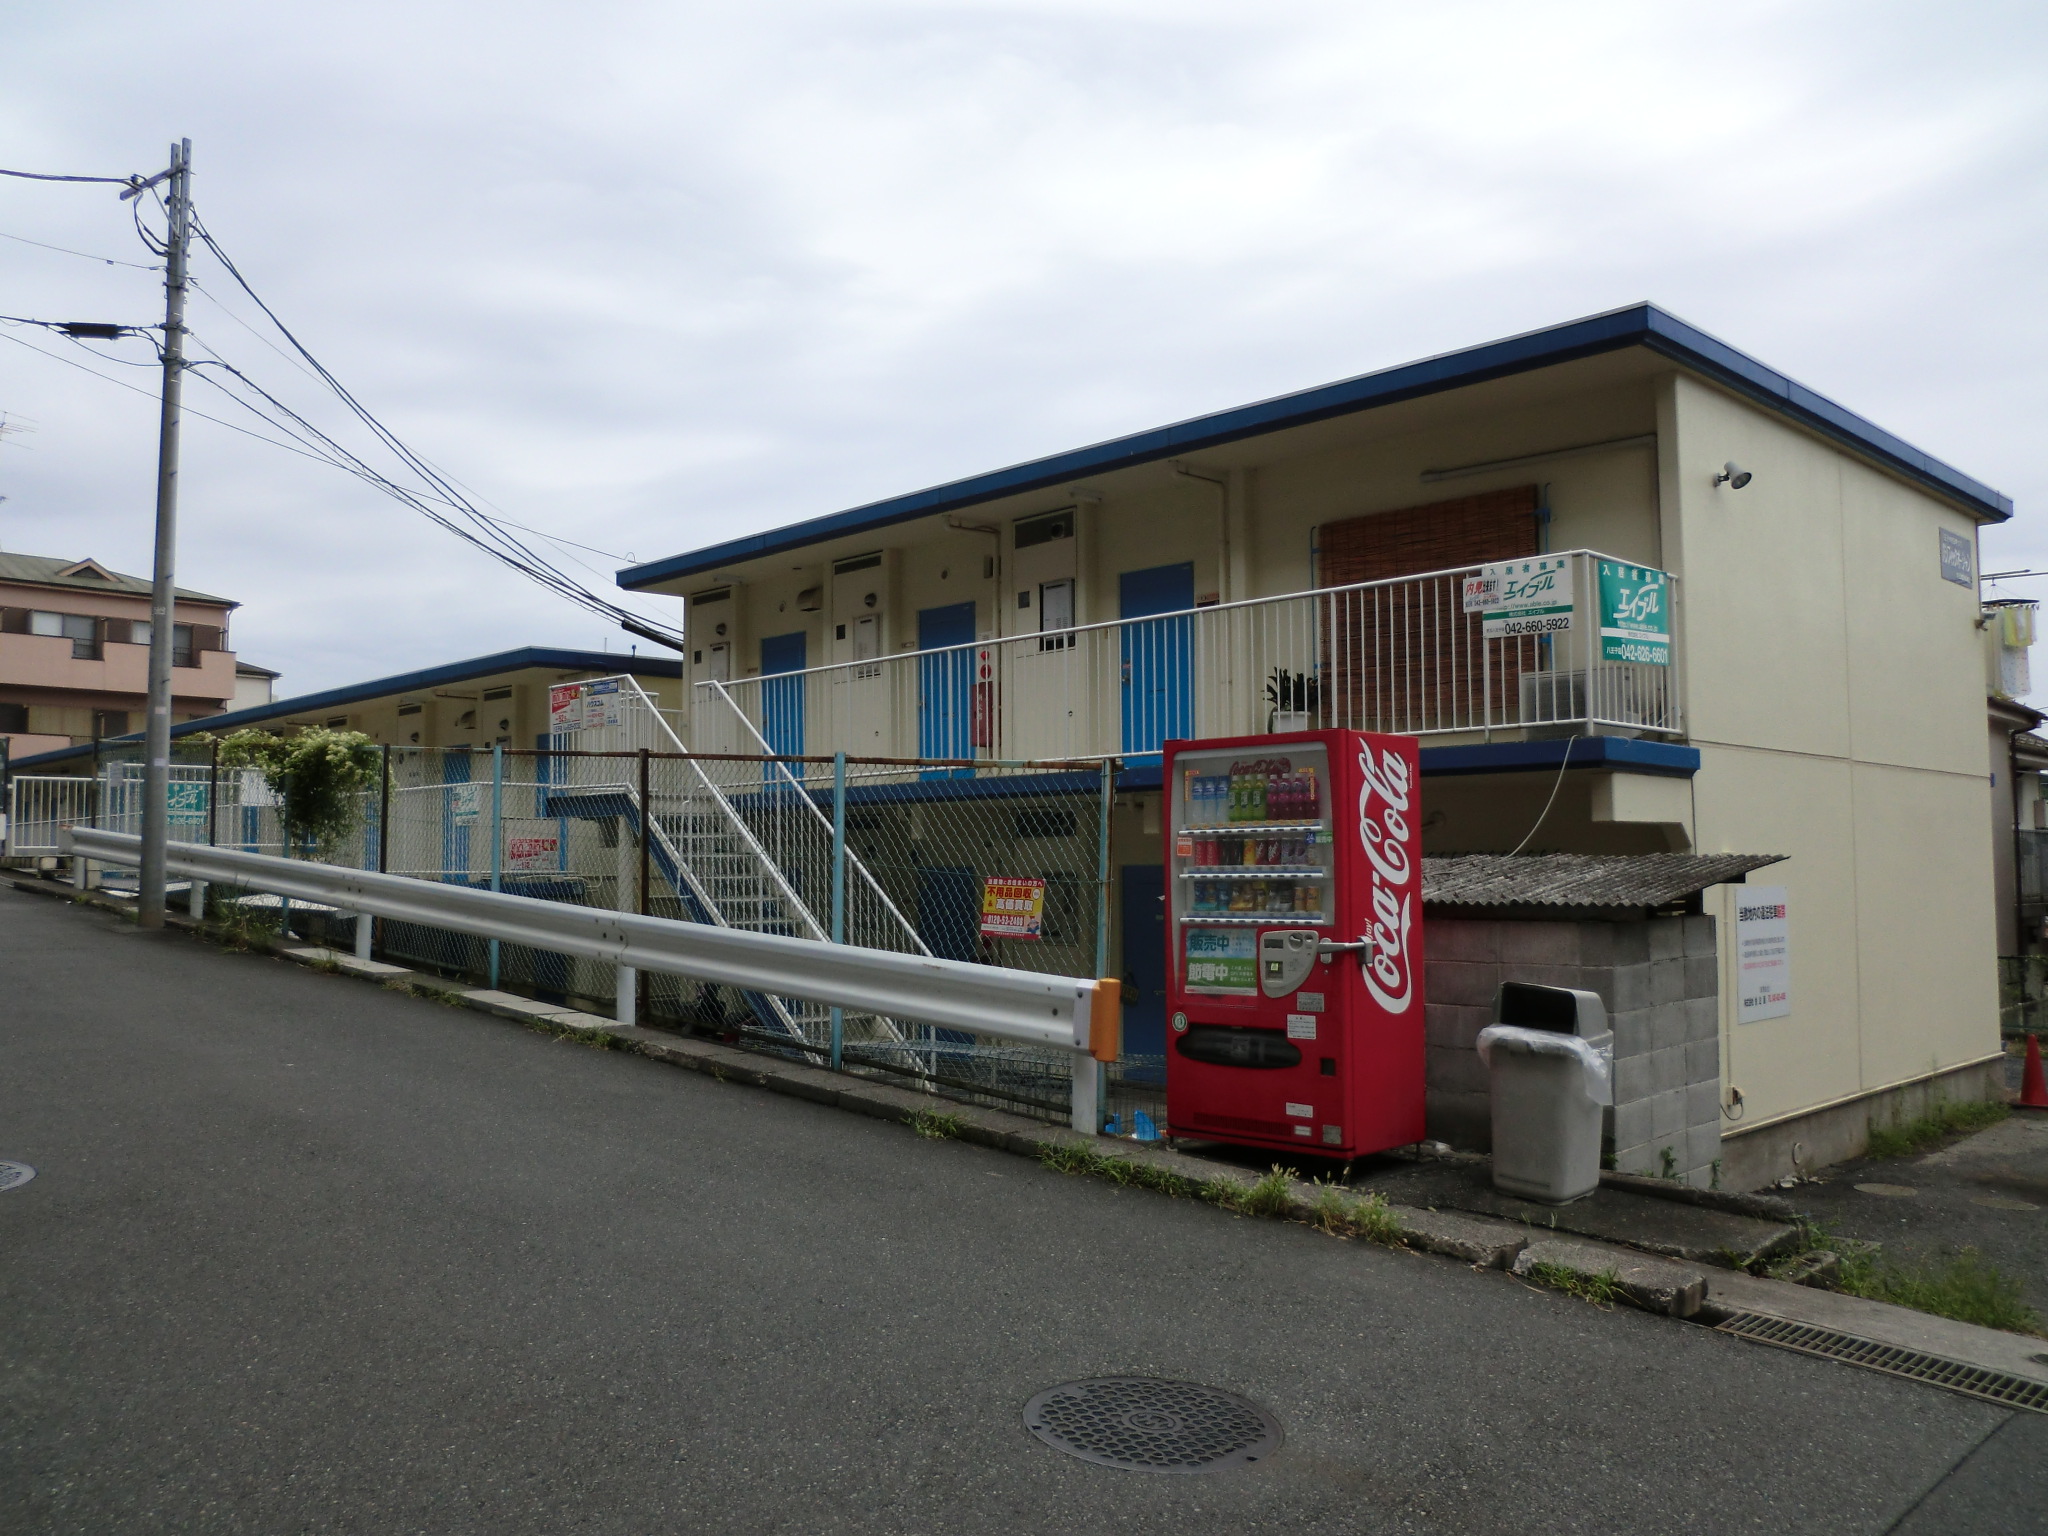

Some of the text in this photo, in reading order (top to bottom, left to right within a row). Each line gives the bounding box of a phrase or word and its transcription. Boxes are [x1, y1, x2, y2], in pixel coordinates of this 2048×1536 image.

[1489, 560, 1565, 575] 入居者募集
[1602, 564, 1665, 585] 入居者募集
[1503, 570, 1557, 601] エイブル
[1612, 583, 1660, 621] エイブル
[1505, 617, 1569, 635] 042-660-5922
[1621, 643, 1669, 664] 042-626-6601
[1357, 736, 1412, 1014] Coca-Cola
[987, 886, 1031, 898] 不用品回収
[996, 899, 1033, 911] 高価買取
[1189, 934, 1230, 952] 販売中
[1188, 963, 1229, 982] 節電中
